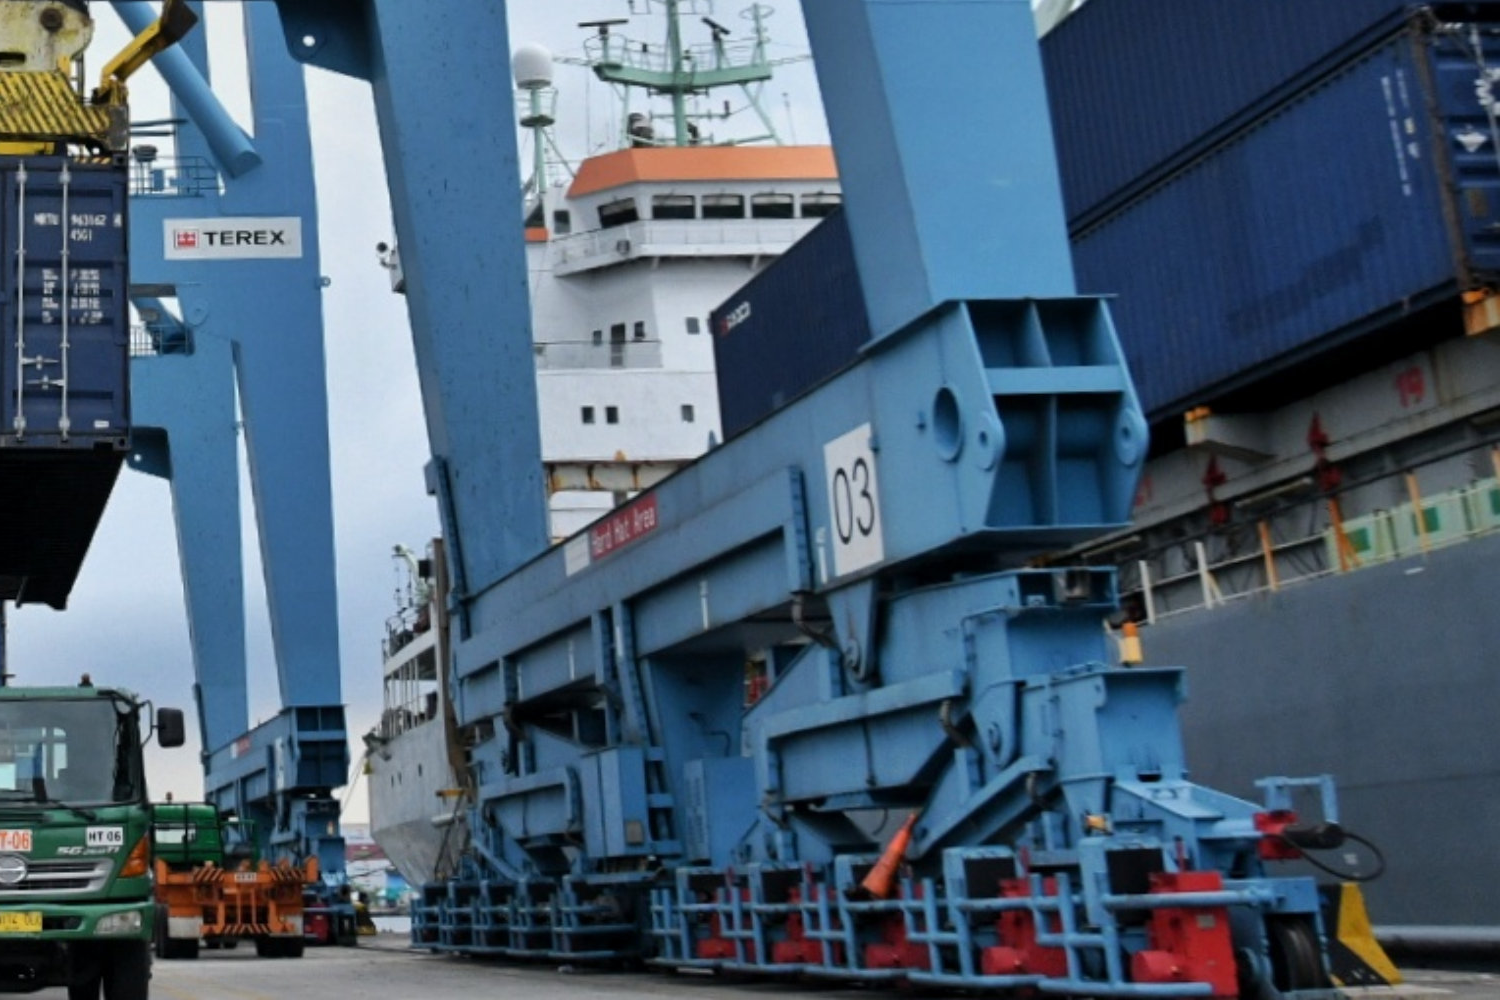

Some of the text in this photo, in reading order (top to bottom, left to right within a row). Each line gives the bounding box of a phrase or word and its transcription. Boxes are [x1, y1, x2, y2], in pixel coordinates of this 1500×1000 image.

[203, 230, 284, 246] TEREX
[833, 457, 875, 545] 03
[89, 831, 121, 843] HT 06
